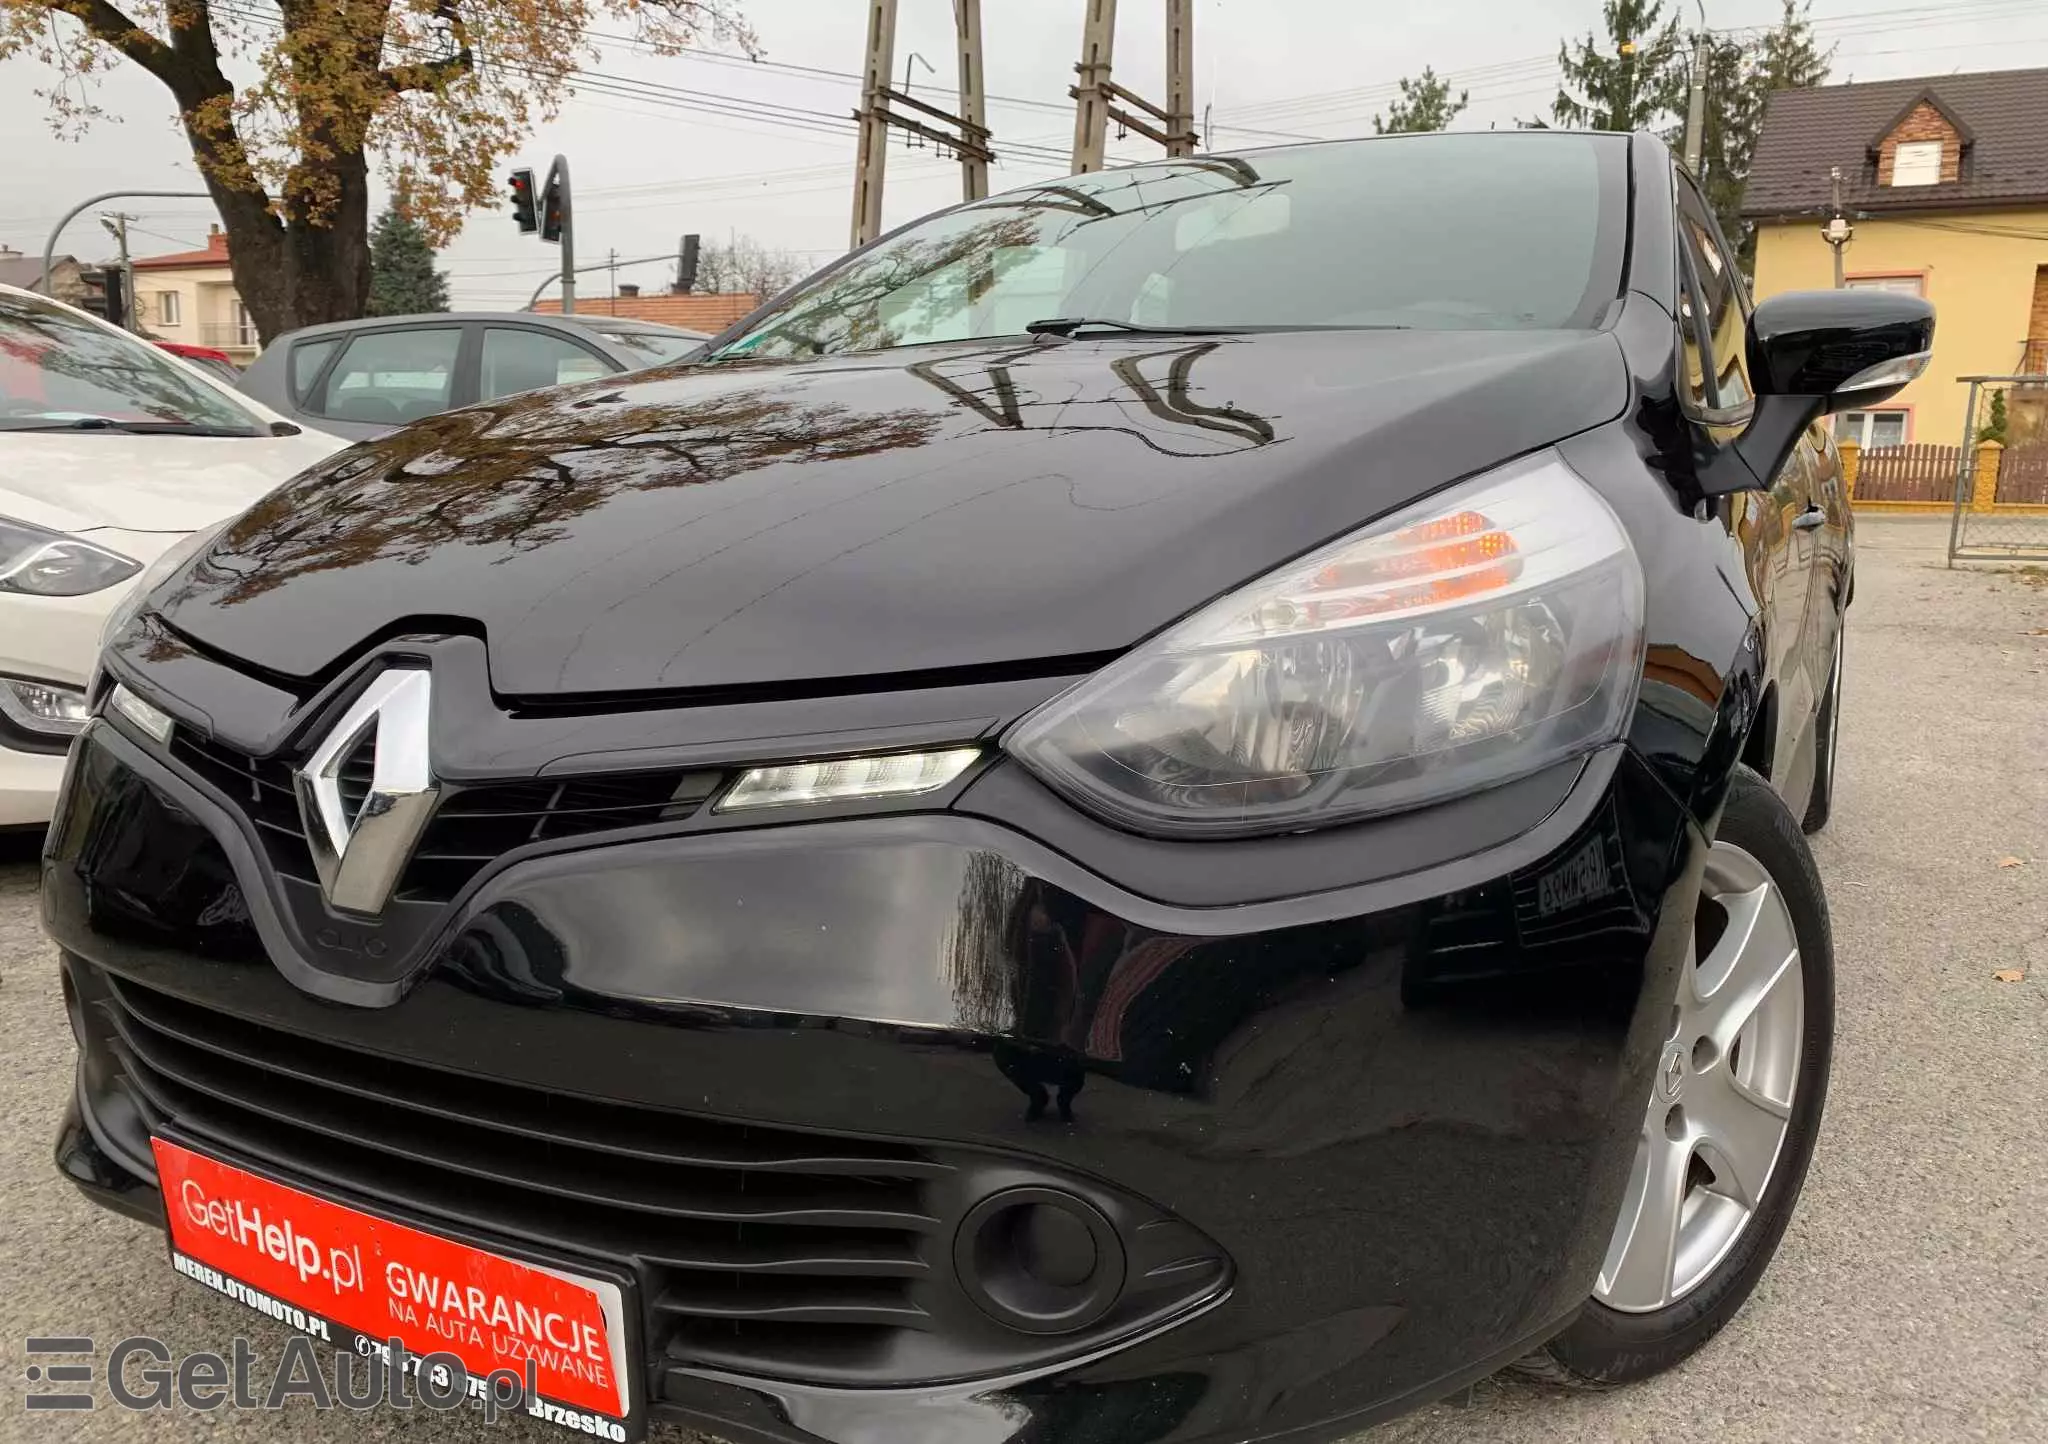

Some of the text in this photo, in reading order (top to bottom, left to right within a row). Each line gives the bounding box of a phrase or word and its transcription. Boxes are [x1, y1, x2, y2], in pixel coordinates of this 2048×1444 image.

[316, 928, 388, 958] CLIO
[182, 1179, 364, 1295] GetHelp.pl
[385, 1262, 603, 1362] GWARANCJE
[388, 1297, 608, 1388] NA AUTA UŻYWANE
[528, 1396, 626, 1443] Brzesko
